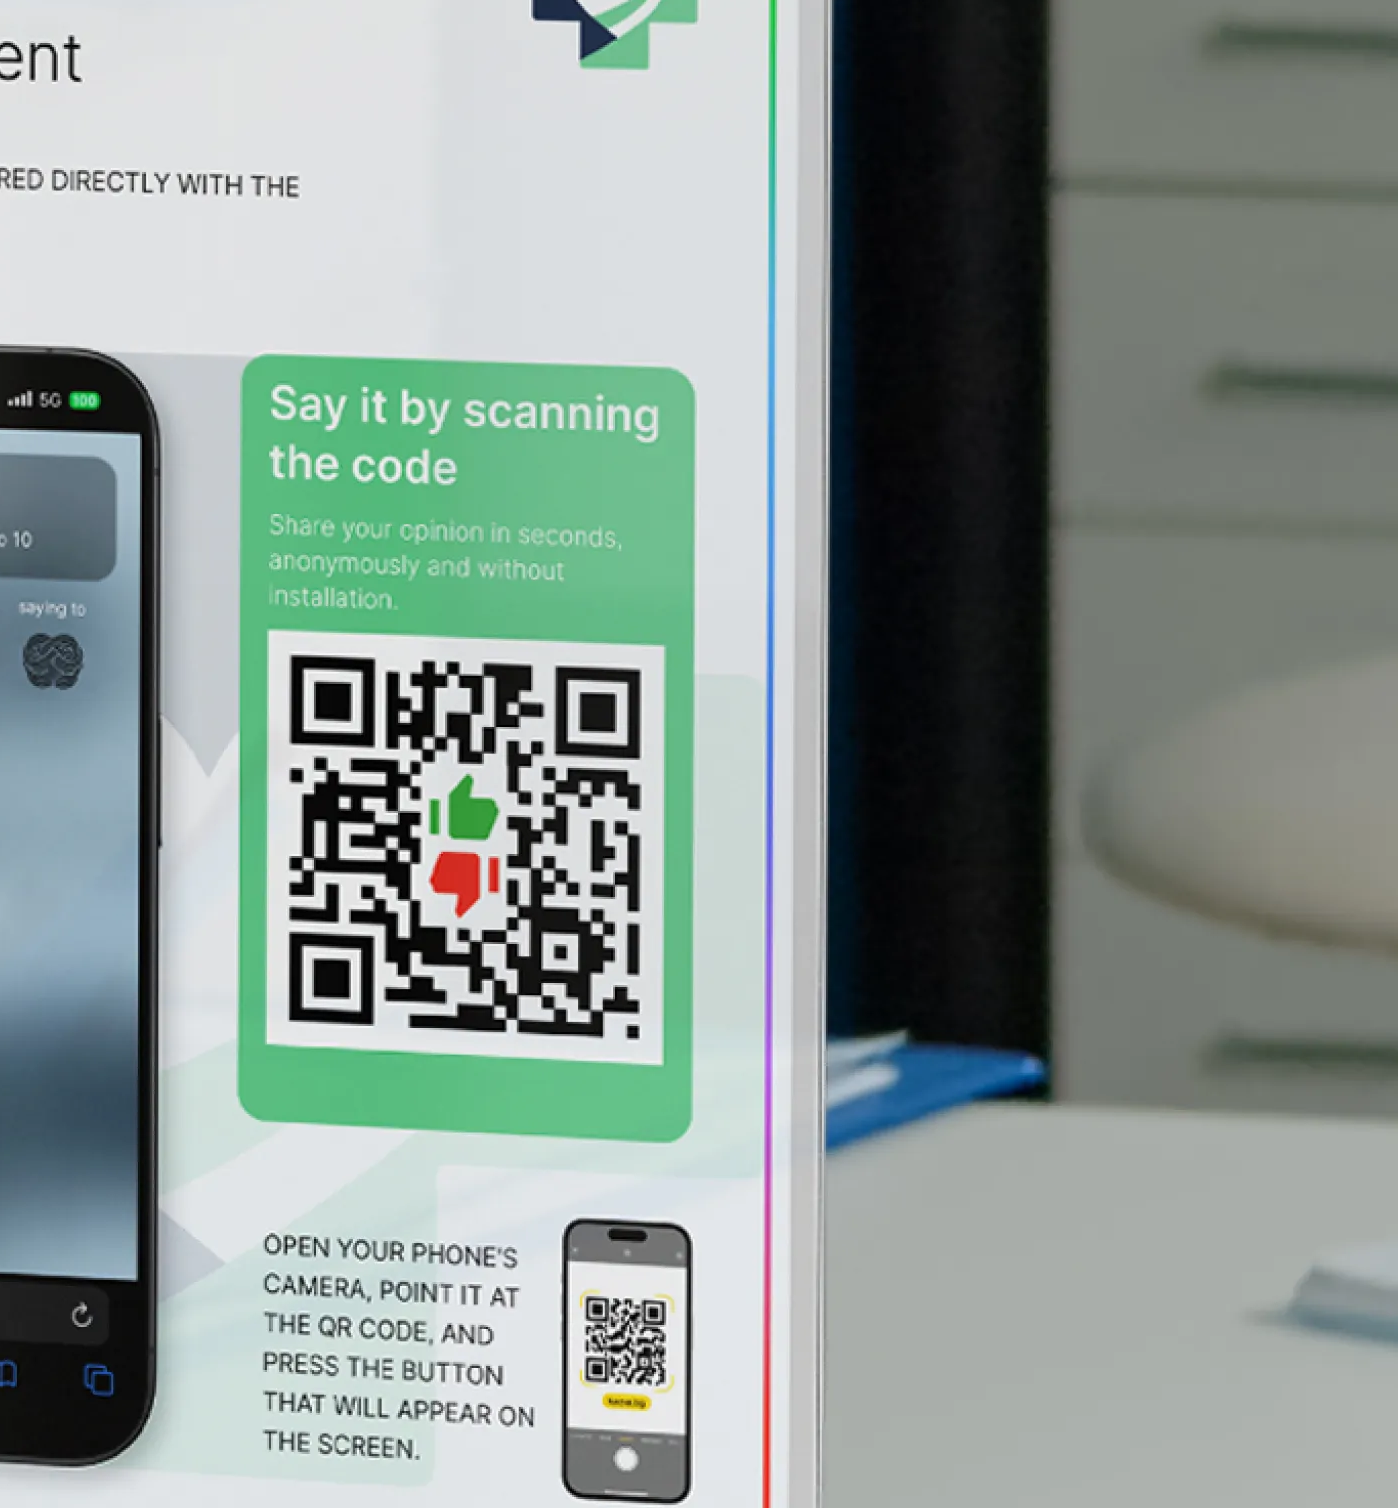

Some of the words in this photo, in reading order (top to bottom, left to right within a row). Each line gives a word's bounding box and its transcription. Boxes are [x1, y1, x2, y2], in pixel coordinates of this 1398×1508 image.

[52, 170, 170, 193] DIRECTLY
[177, 174, 242, 195] WITH
[250, 176, 298, 197] THE
[40, 393, 62, 408] 5G
[73, 394, 97, 407] 100
[271, 385, 347, 430] Say
[362, 387, 386, 424] it
[402, 389, 450, 434] by
[465, 395, 658, 442] scanning
[269, 444, 339, 481] the
[353, 449, 457, 485] code
[13, 531, 32, 548] 10
[271, 514, 335, 537] Share
[343, 522, 392, 543] your
[400, 520, 484, 545] opinion
[492, 522, 510, 543] in
[519, 527, 621, 551] seconds,
[269, 553, 420, 580] anonymously
[427, 557, 470, 578] and
[478, 560, 564, 581] without
[71, 602, 87, 617] to
[269, 587, 397, 609] installation.
[265, 1233, 329, 1257] OPEN
[337, 1239, 404, 1261] YOUR
[412, 1243, 517, 1268] PHONE'S
[265, 1272, 371, 1302] CAMERA,
[381, 1280, 453, 1302] POINT
[461, 1284, 482, 1305] IT
[490, 1288, 519, 1307] AT
[265, 1312, 310, 1335] THE
[318, 1316, 351, 1337] QR
[359, 1317, 433, 1344] CODE,
[441, 1323, 494, 1345] AND
[263, 1352, 339, 1376] PRESS
[347, 1356, 394, 1380] THE
[402, 1360, 502, 1385] BUTTON
[265, 1391, 326, 1413] THAT
[334, 1395, 389, 1419] WILL
[398, 1400, 490, 1424] APPEAR
[499, 1405, 533, 1427] ON
[264, 1430, 310, 1452] THE
[318, 1433, 419, 1460] SCREEN.
